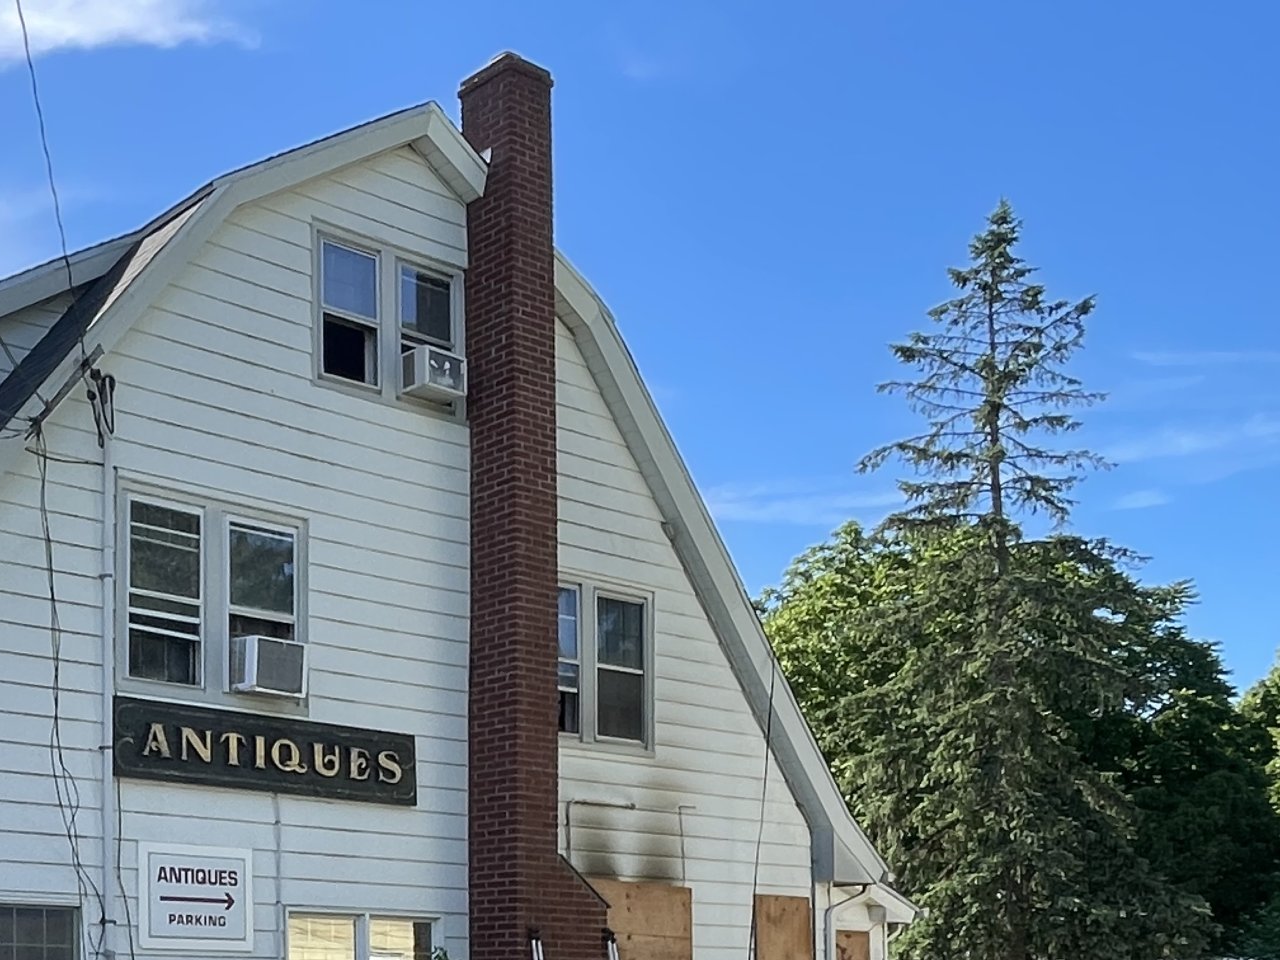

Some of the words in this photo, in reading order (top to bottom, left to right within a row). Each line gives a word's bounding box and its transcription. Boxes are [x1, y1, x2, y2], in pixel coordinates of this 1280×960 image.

[142, 722, 403, 785] ANTIQUES
[157, 866, 239, 887] ANTIQUES
[168, 913, 227, 927] PARKING
